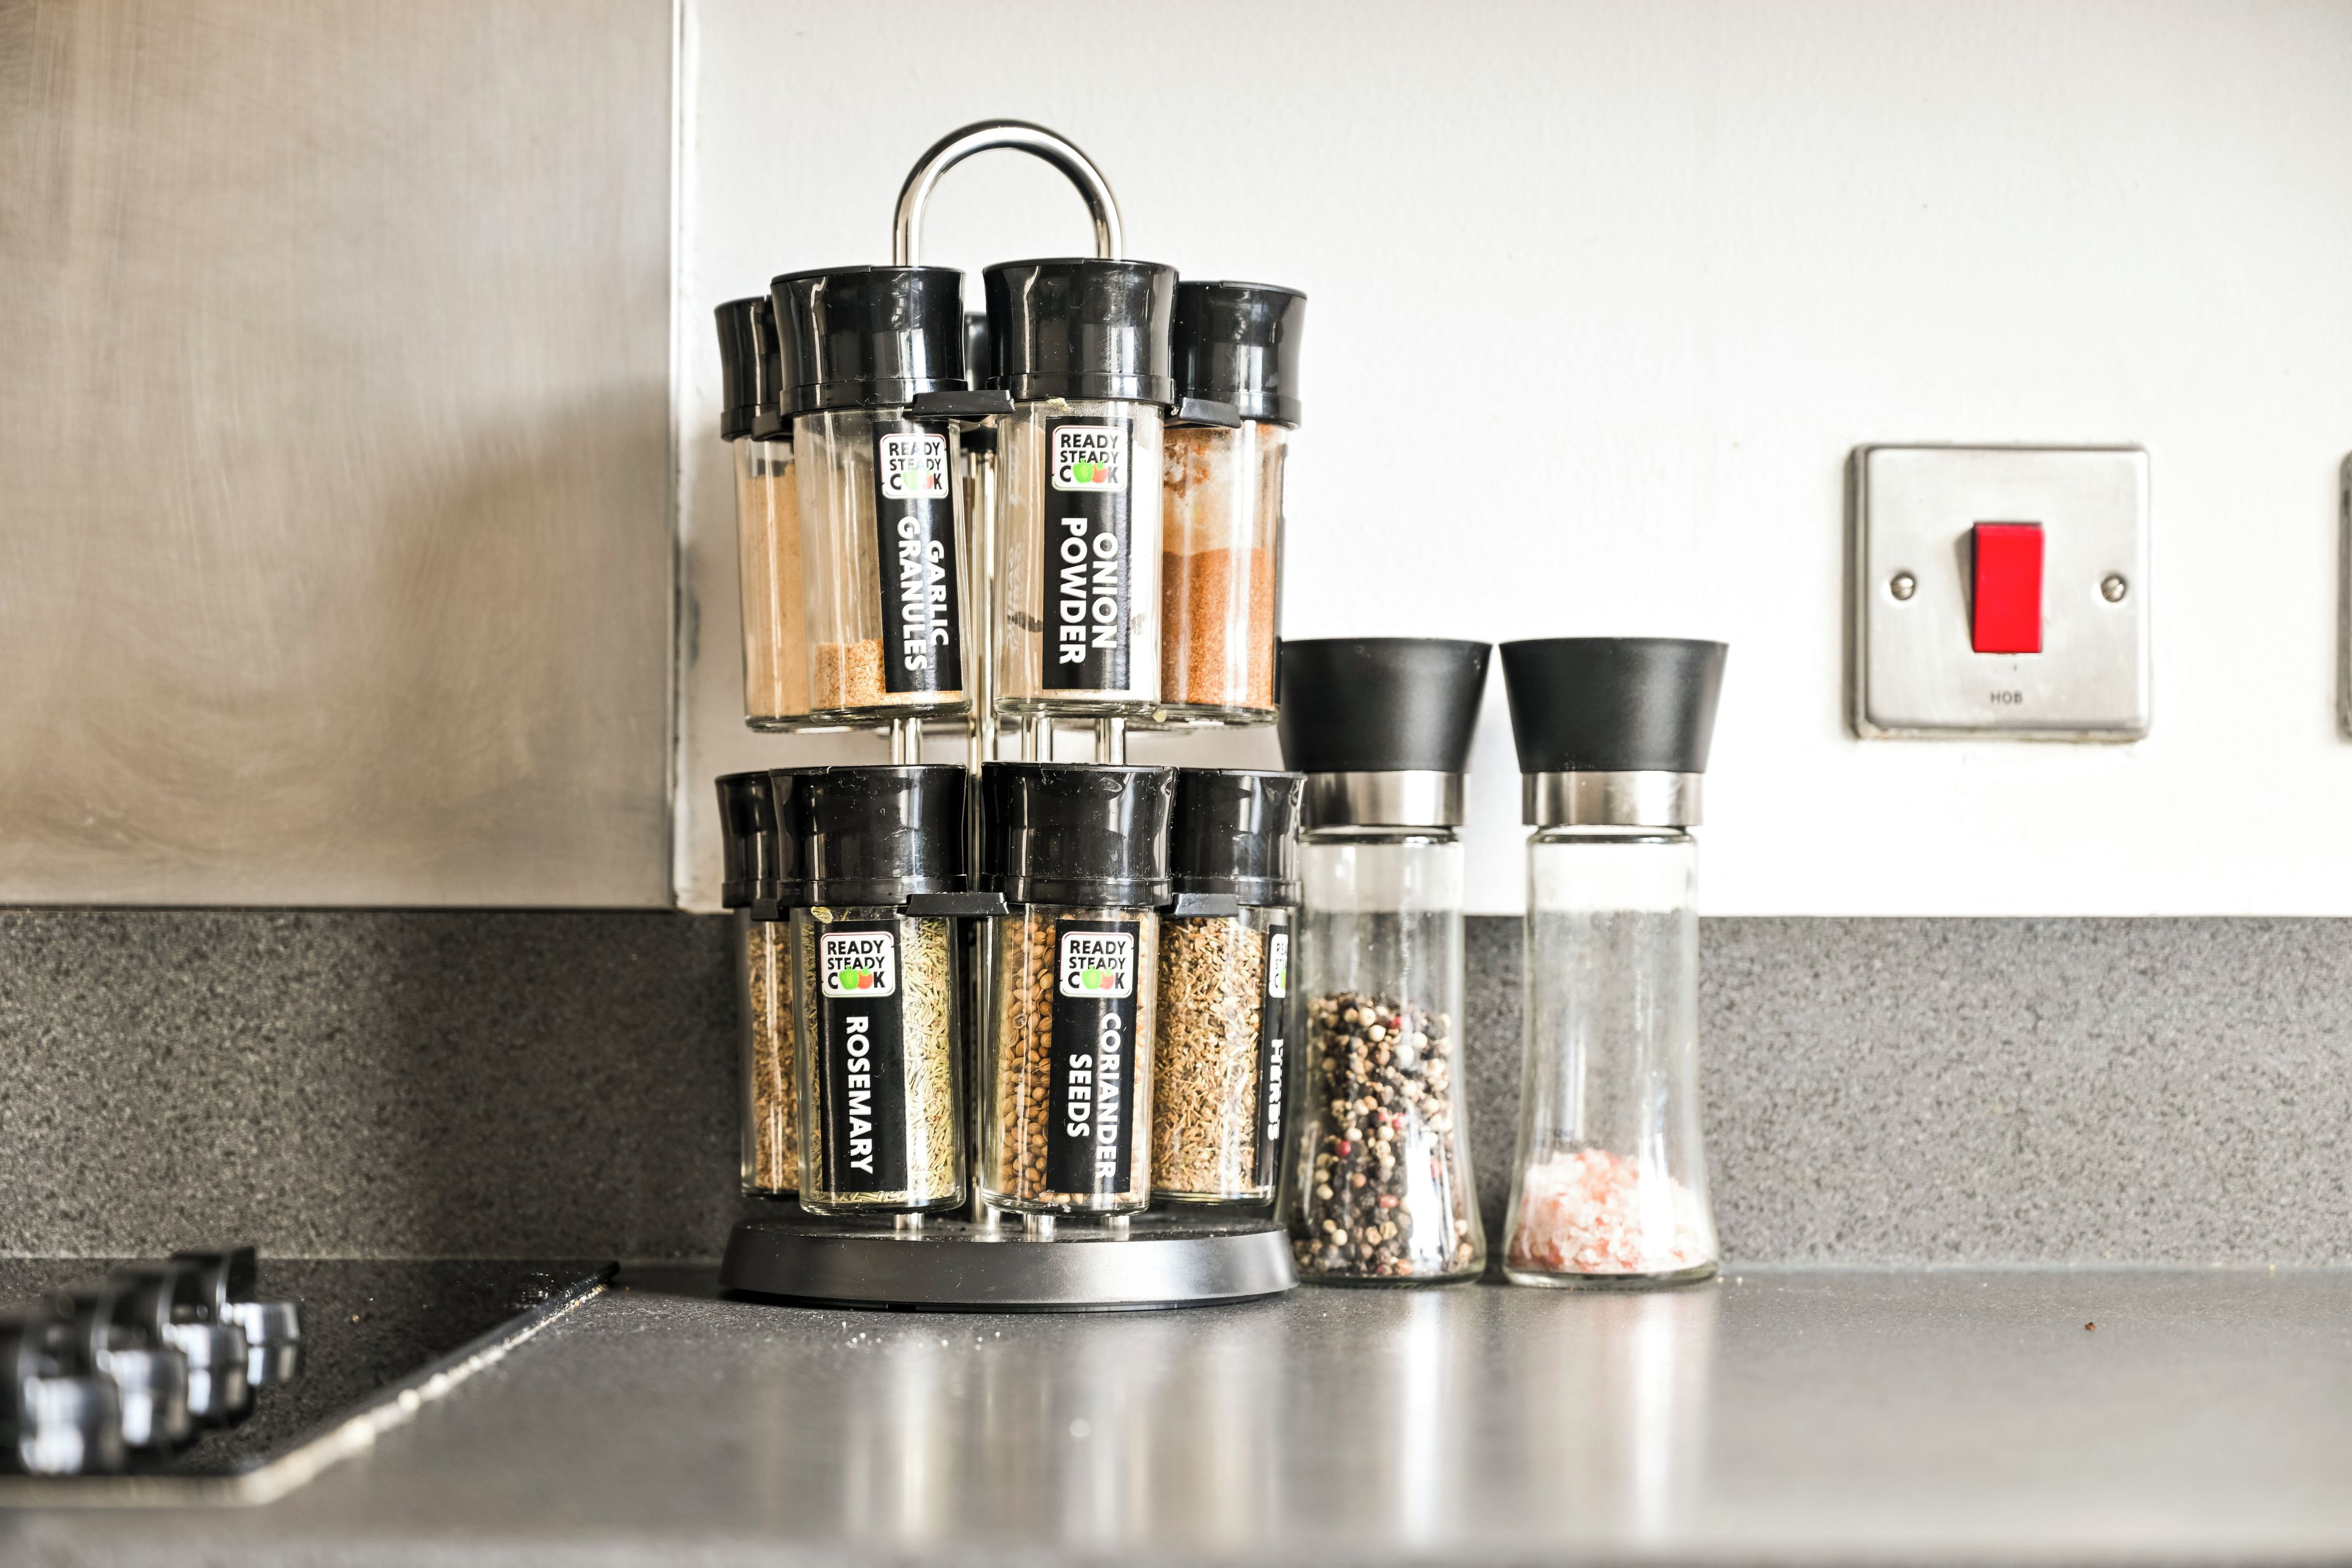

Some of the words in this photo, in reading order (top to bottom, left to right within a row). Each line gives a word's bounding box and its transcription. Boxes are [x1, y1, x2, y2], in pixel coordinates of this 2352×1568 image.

[889, 442, 940, 456] READY
[1061, 434, 1120, 449] READY
[889, 458, 941, 471] STEADY
[1060, 450, 1120, 464] STEADY
[897, 516, 927, 671] GRANULES
[925, 540, 949, 646] GARLIC
[1059, 518, 1088, 665] POWDER
[1091, 532, 1118, 648] ONION
[1990, 690, 2023, 706] HOB
[827, 940, 884, 955] READY
[1070, 940, 1126, 954] READY
[827, 956, 885, 970] STEADY
[1069, 956, 1126, 970] STEADY
[846, 1016, 873, 1175] ROSEMARY
[1066, 1054, 1093, 1137] SEEDS
[1096, 1012, 1121, 1178] CORIANDER
[1267, 1039, 1281, 1141] HERBS
